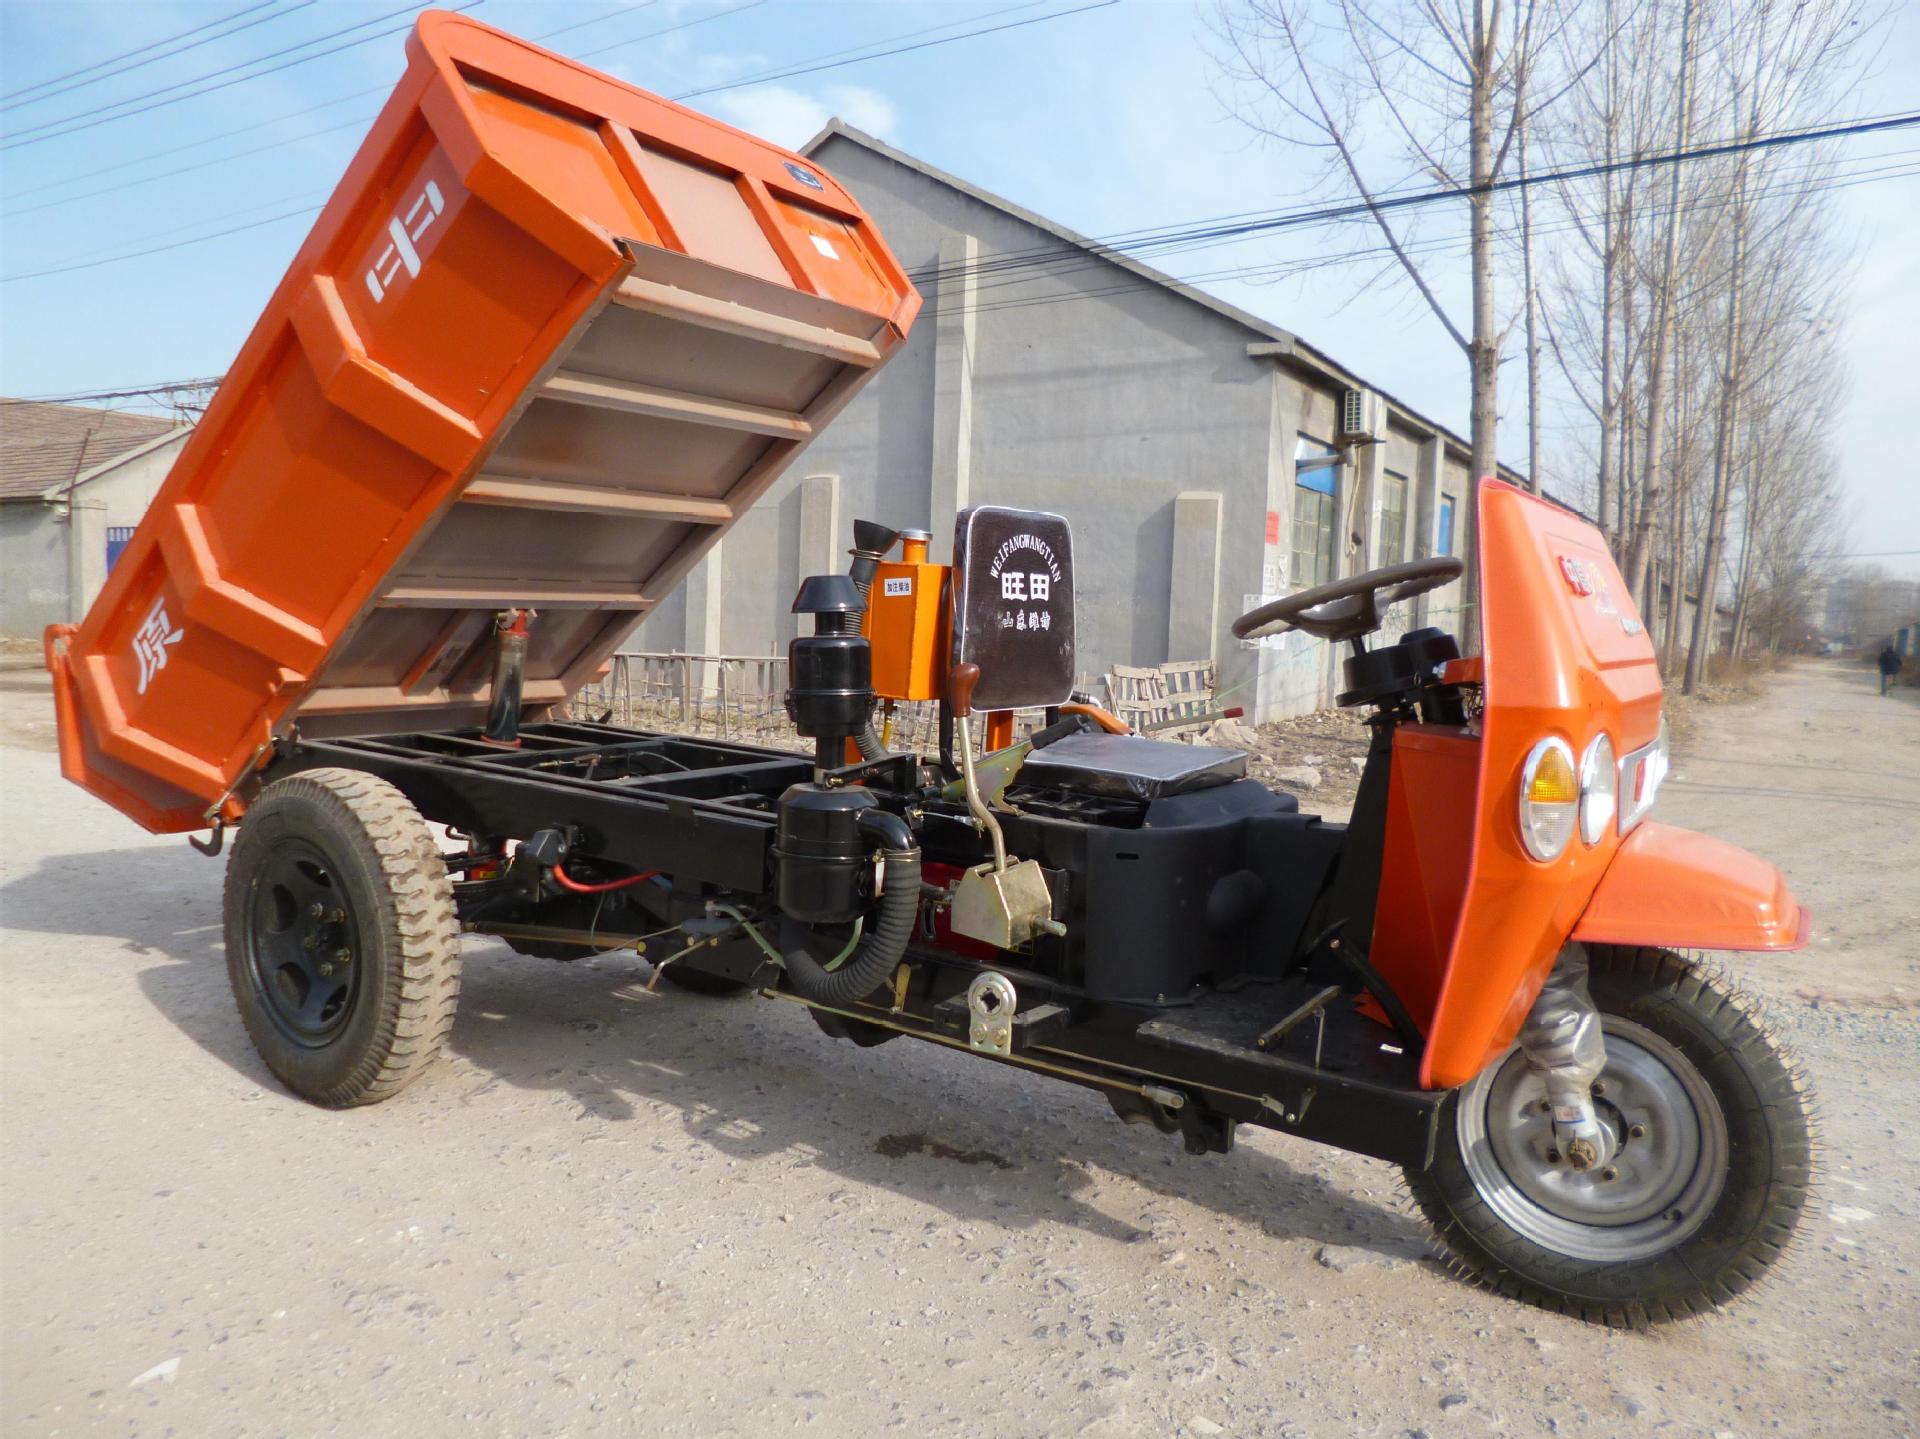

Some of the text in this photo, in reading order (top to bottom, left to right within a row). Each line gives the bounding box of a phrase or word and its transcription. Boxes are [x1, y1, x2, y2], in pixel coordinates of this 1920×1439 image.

[132, 180, 445, 695] 中 原
[990, 534, 1062, 583] WEIFANGWANGTIAN
[1001, 571, 1050, 602] 旺田
